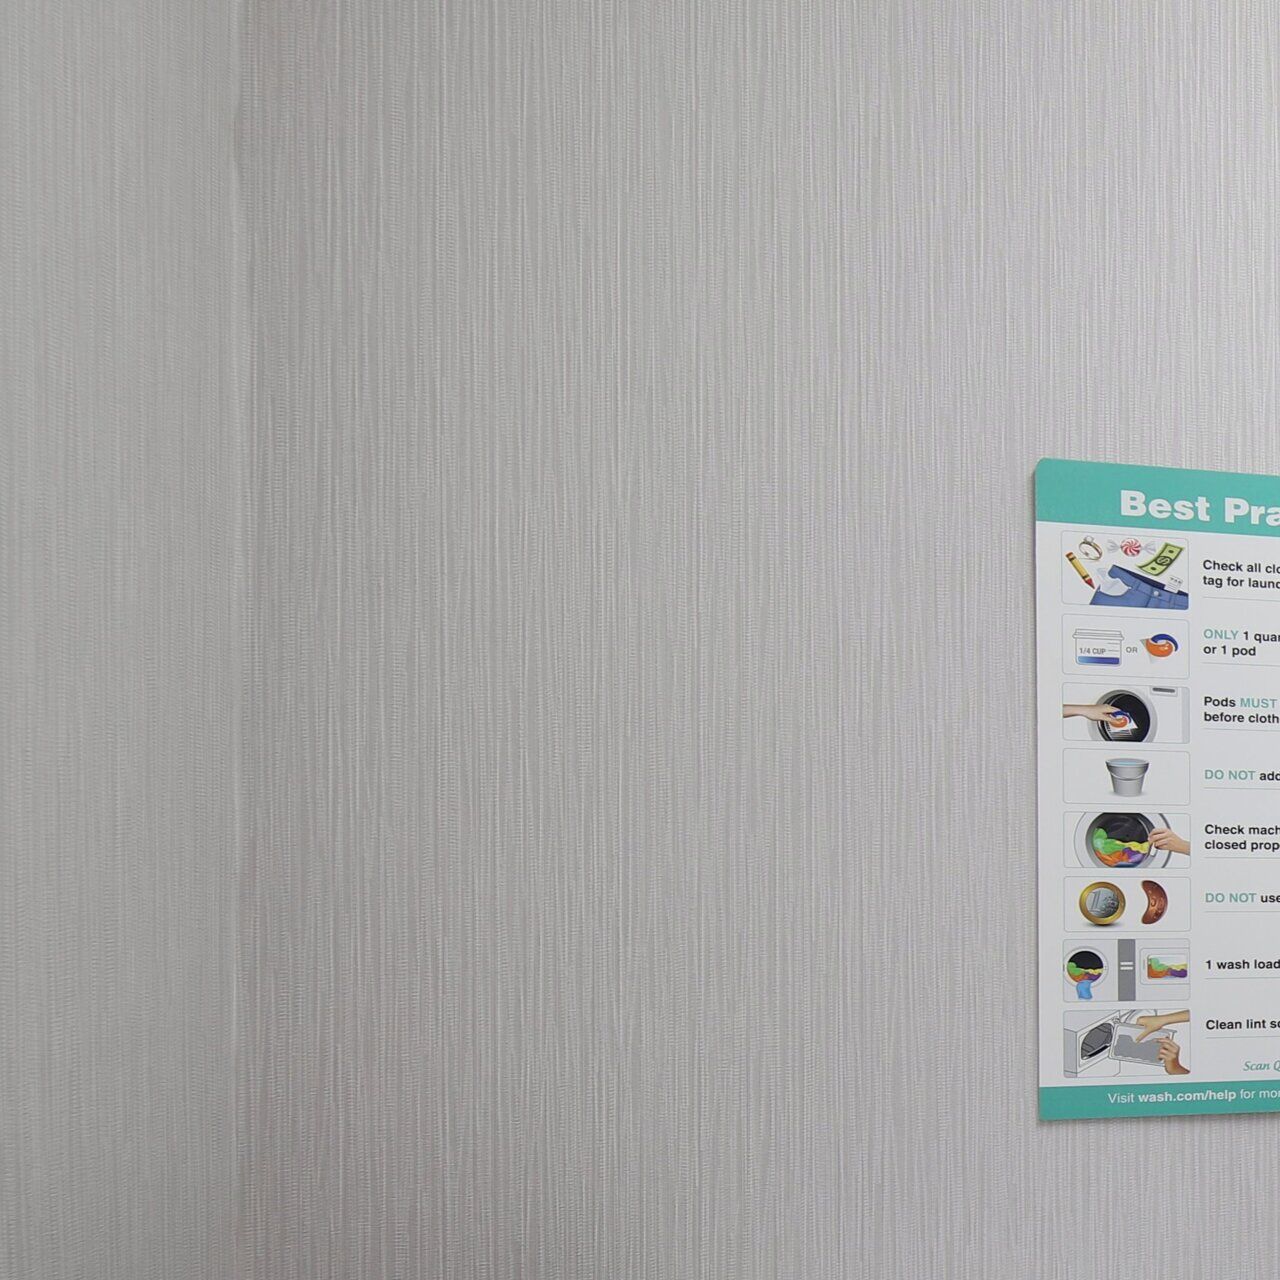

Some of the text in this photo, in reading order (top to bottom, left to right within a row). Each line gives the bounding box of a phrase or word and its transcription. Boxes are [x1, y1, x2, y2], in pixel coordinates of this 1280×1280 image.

[1120, 489, 1210, 522] Best
[1202, 559, 1243, 572] Check
[1246, 562, 1261, 573] all
[1202, 575, 1223, 588] tag
[1226, 576, 1244, 587] for
[1204, 629, 1238, 639] ONLY
[1243, 631, 1248, 640] 1
[1203, 645, 1256, 658] or 1 pod
[1204, 696, 1236, 707] Pods
[1239, 697, 1277, 708] MUST
[1204, 711, 1244, 723] before
[1205, 770, 1223, 779] DO
[1229, 770, 1254, 779] NOT
[1204, 824, 1245, 835] Check
[1204, 839, 1247, 850] closed
[1206, 893, 1224, 902] DO
[1230, 893, 1254, 902] NOT
[1206, 1019, 1242, 1030] Clean
[1246, 1019, 1266, 1029] lint
[1243, 1060, 1270, 1071] Scan
[1107, 1092, 1135, 1103] Visit
[1137, 1089, 1236, 1103] wash.com/help
[1240, 1088, 1256, 1099] for
